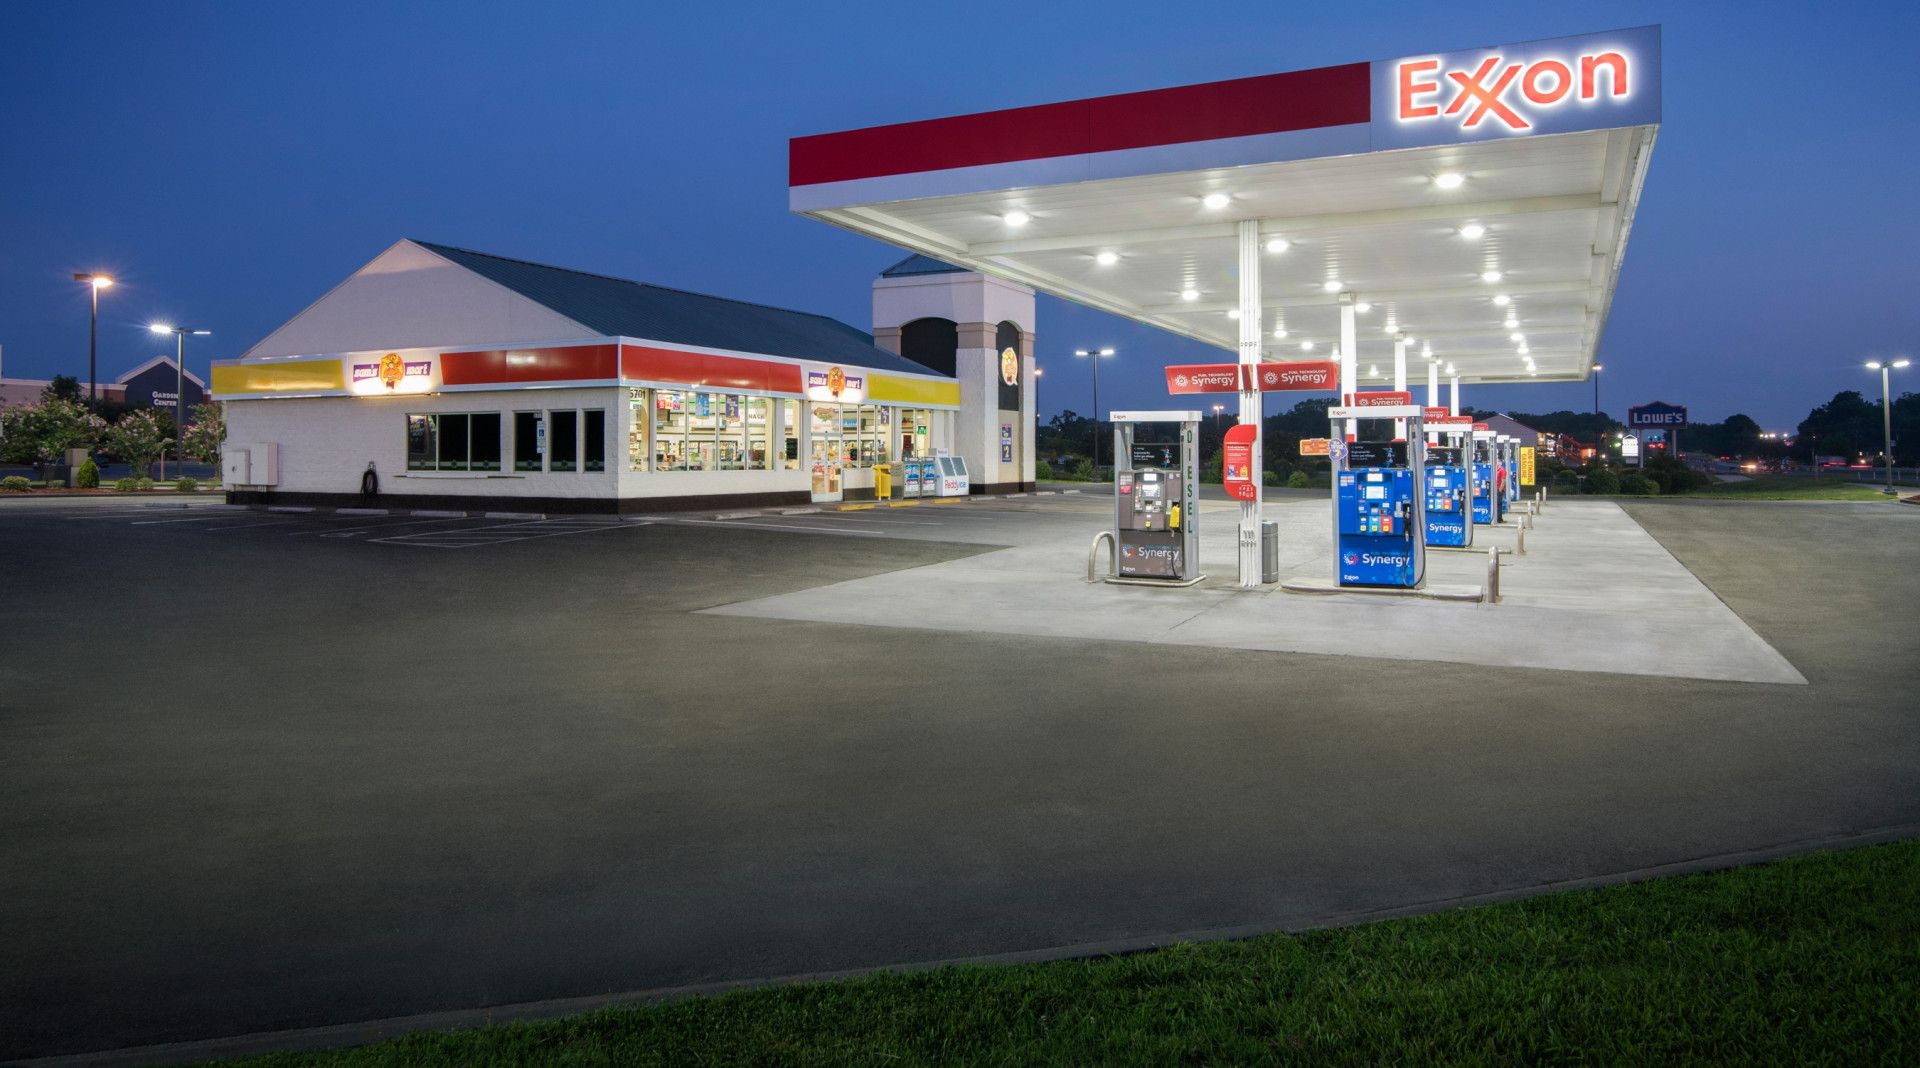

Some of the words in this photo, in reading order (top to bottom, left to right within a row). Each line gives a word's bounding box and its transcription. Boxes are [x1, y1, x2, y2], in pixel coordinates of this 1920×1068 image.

[1399, 51, 1628, 129] Exxon
[1191, 375, 1235, 387] Synergy
[1281, 373, 1328, 384] Synergy
[152, 391, 179, 399] GARDEN
[153, 399, 177, 407] CENTER
[1633, 412, 1684, 424] LOWE'S
[1429, 523, 1463, 534] Synergy
[1138, 546, 1180, 560] Synergy
[1362, 553, 1411, 567] Synergy
